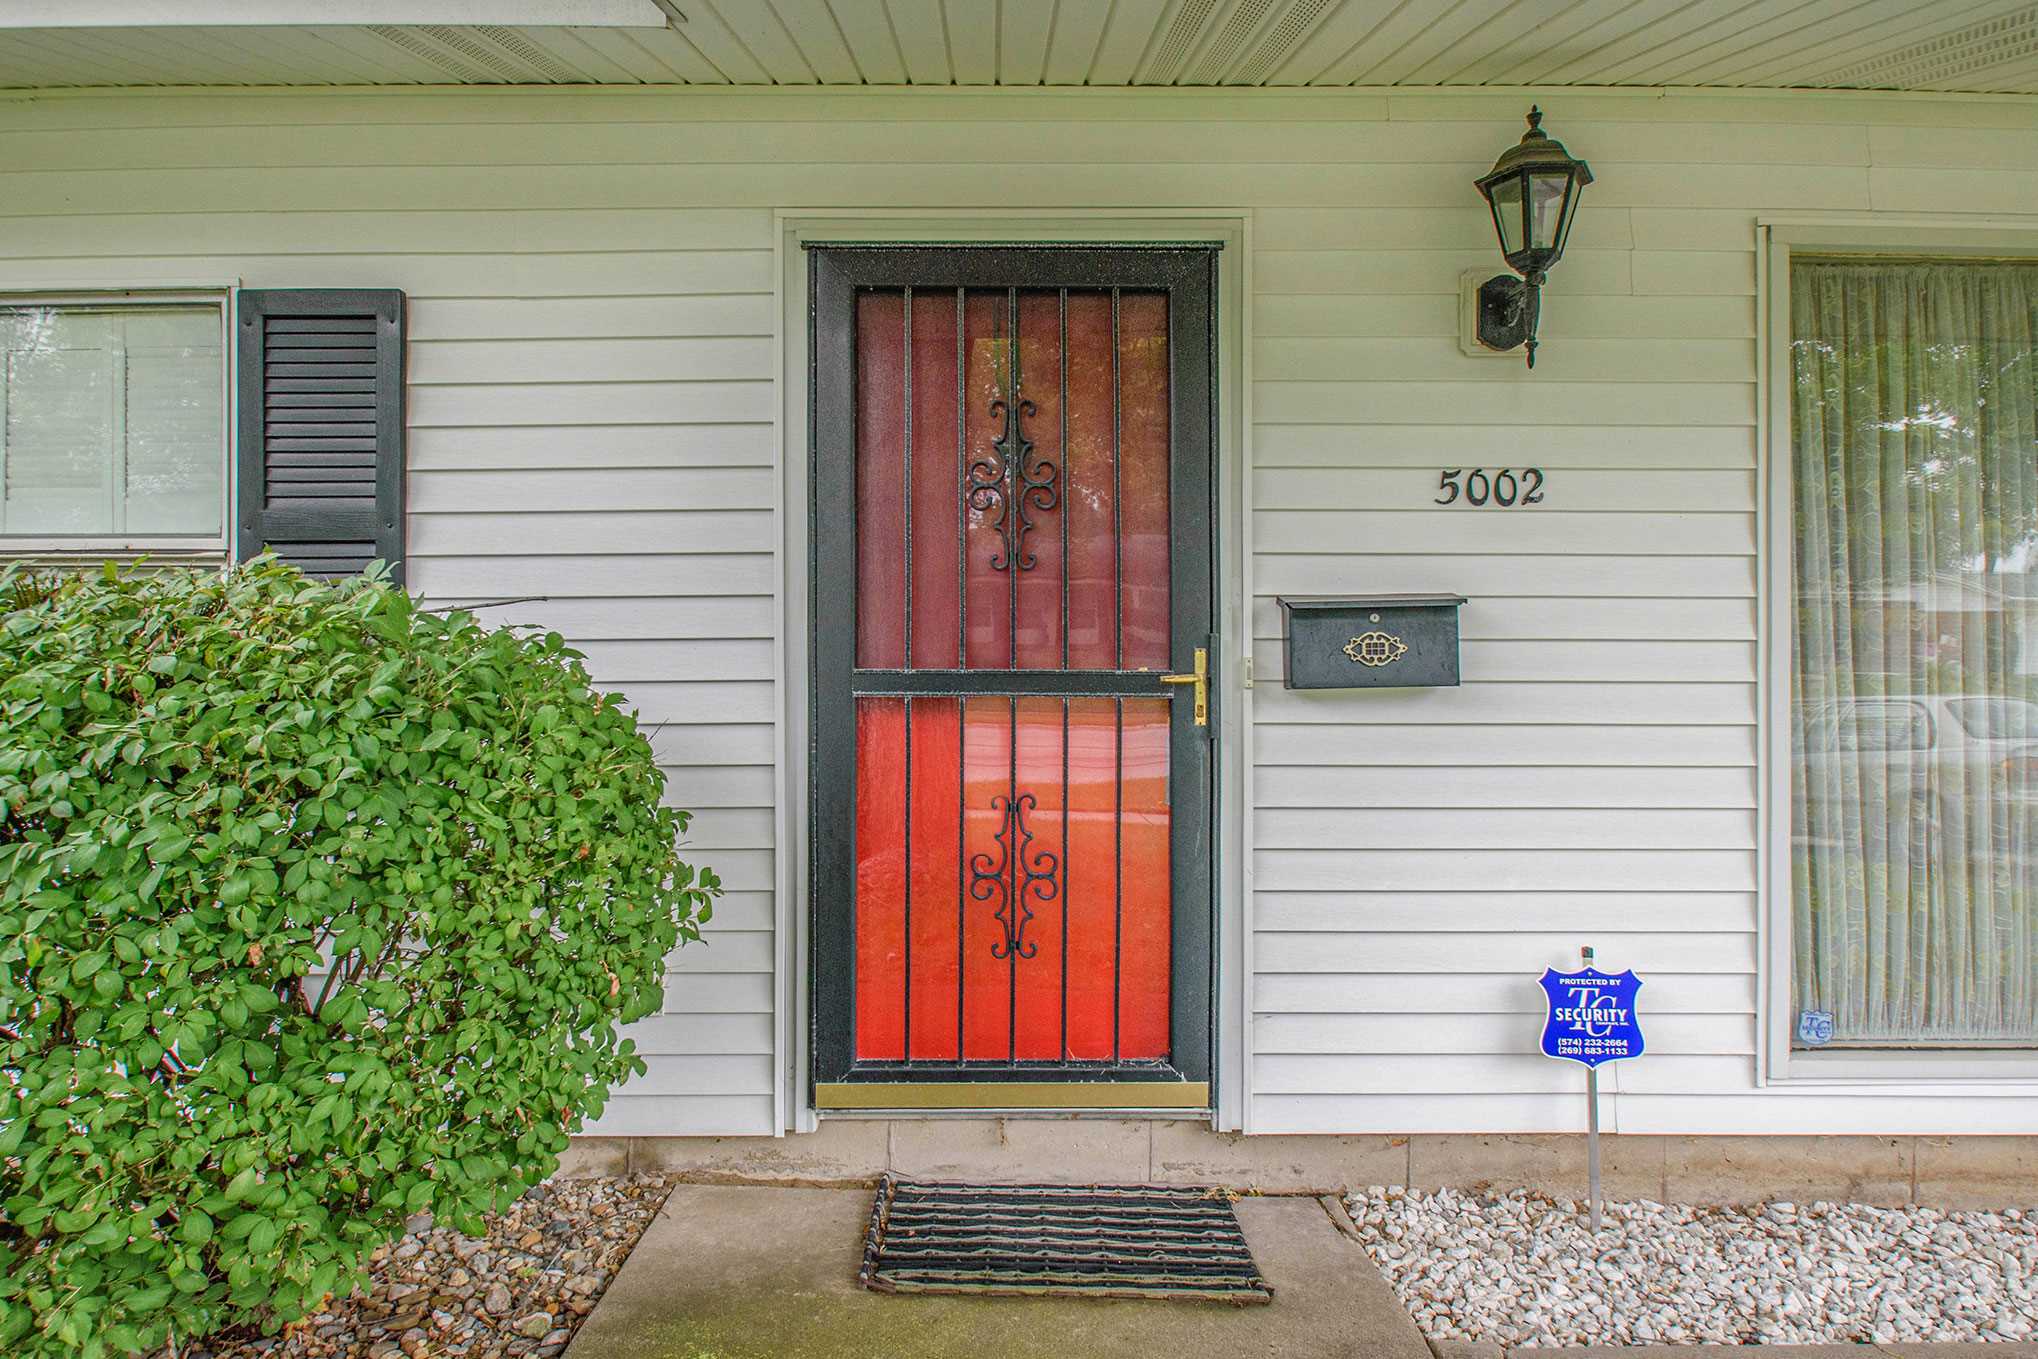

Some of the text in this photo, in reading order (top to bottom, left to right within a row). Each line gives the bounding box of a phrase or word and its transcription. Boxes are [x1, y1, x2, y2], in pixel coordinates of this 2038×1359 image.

[1434, 468, 1544, 507] 5002
[1559, 978, 1607, 986] PROTECTED
[1555, 1007, 1628, 1022] SECURITY
[1558, 1038, 1628, 1047] (574) 232-2664
[1558, 1046, 1628, 1056] (269) 683-1133
